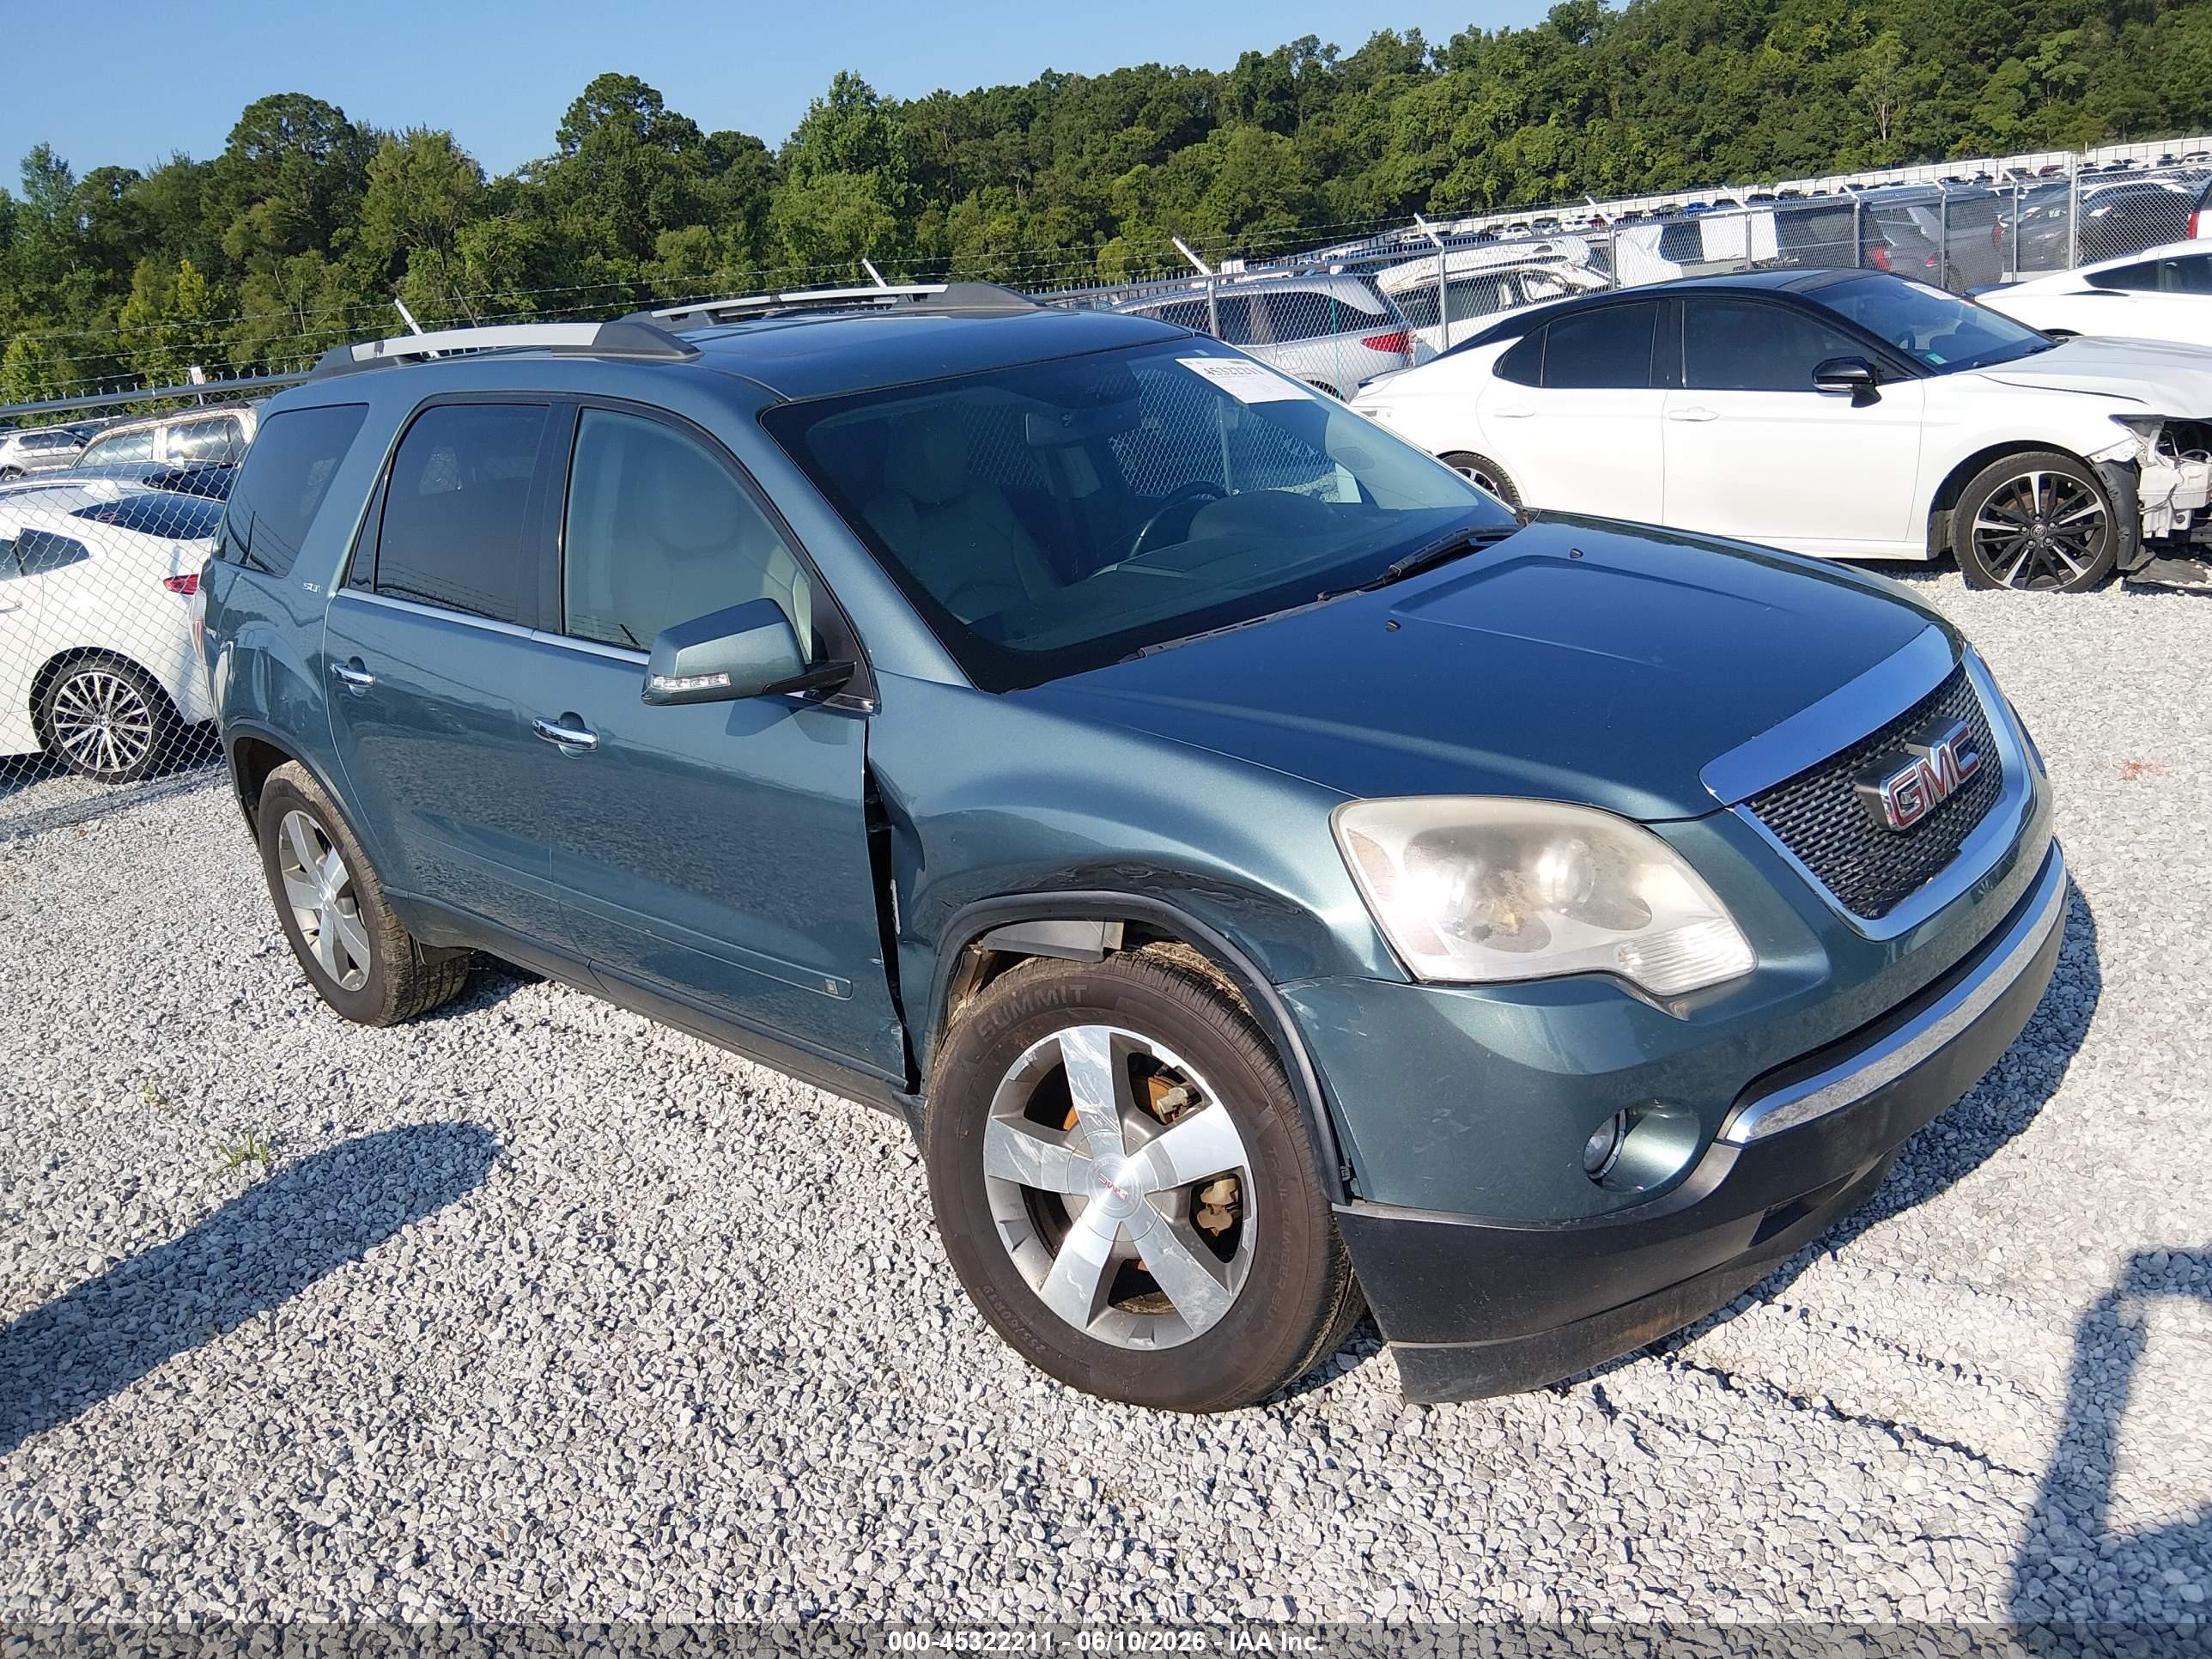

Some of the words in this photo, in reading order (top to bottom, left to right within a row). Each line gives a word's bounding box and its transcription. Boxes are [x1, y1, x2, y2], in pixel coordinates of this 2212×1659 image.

[1881, 720, 1981, 831] GMC
[976, 984, 1088, 1042] SUMMIT
[1098, 1173, 1128, 1200] GMC
